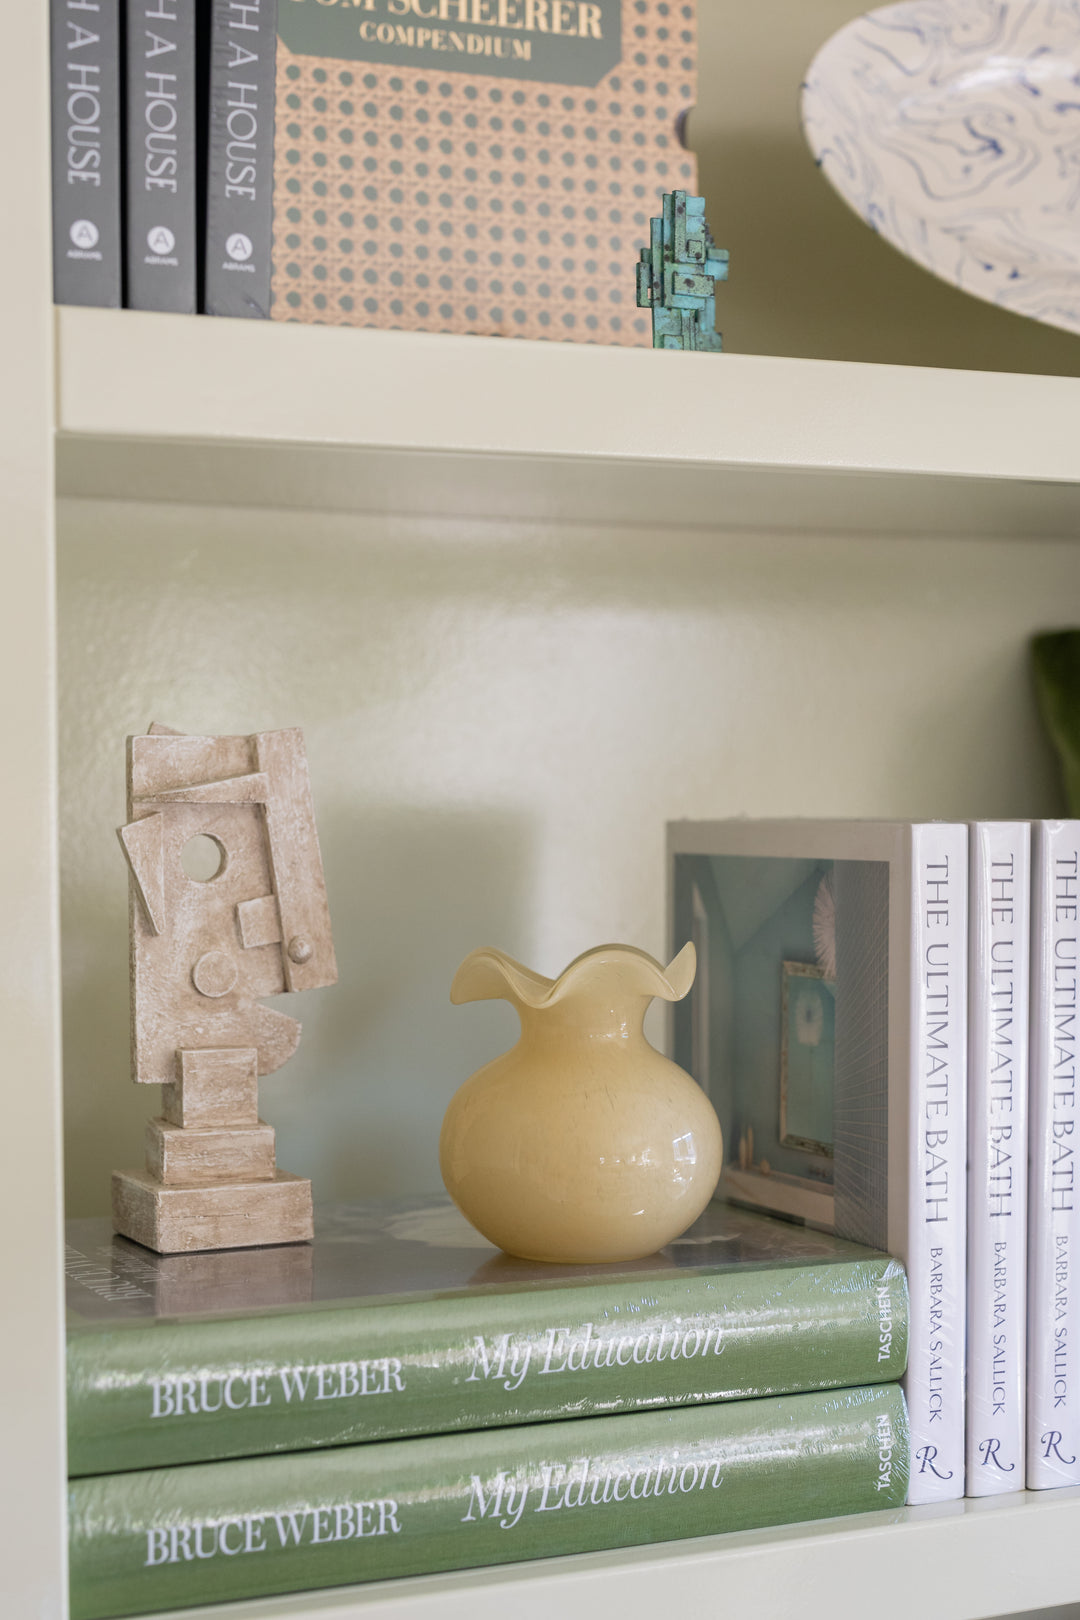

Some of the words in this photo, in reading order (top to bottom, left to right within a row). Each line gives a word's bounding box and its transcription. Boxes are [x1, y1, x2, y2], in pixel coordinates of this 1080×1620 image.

[67, 21, 99, 50] A
[145, 30, 177, 58] A
[228, 41, 258, 68] A
[359, 20, 532, 61] COMPENDIUM
[67, 63, 100, 187] HOUSE
[145, 72, 177, 193] HOUSE
[225, 81, 258, 201] HOUSE
[926, 855, 949, 927] THE
[990, 853, 1015, 926] THE
[1055, 851, 1079, 923] THE
[925, 943, 949, 1119] ULTIMATE
[990, 940, 1014, 1114] ULTIMATE
[1053, 938, 1078, 1110] ULTIMATE
[925, 1129, 949, 1223] BATH
[988, 1125, 1013, 1218] BATH
[1051, 1119, 1076, 1212] BATH
[929, 1247, 944, 1336] BARBARA
[993, 1241, 1008, 1329] BARBARA
[1054, 1235, 1069, 1322] BARBARA
[466, 1332, 530, 1391] My
[538, 1319, 725, 1375] Education
[876, 1286, 892, 1362] TASCHEN
[150, 1375, 271, 1418] BRUCE
[279, 1357, 406, 1403] WEBER
[928, 1340, 943, 1423] SALLICK
[992, 1334, 1007, 1416] SALLICK
[1053, 1327, 1069, 1409] SALLICK
[876, 1413, 891, 1492] TASCHEN
[915, 1445, 953, 1480] R
[978, 1438, 1015, 1472] R
[1040, 1430, 1076, 1465] R
[461, 1473, 529, 1530] My
[534, 1453, 724, 1512] Education
[144, 1517, 267, 1566] BRUCE
[274, 1500, 402, 1545] WEBER
